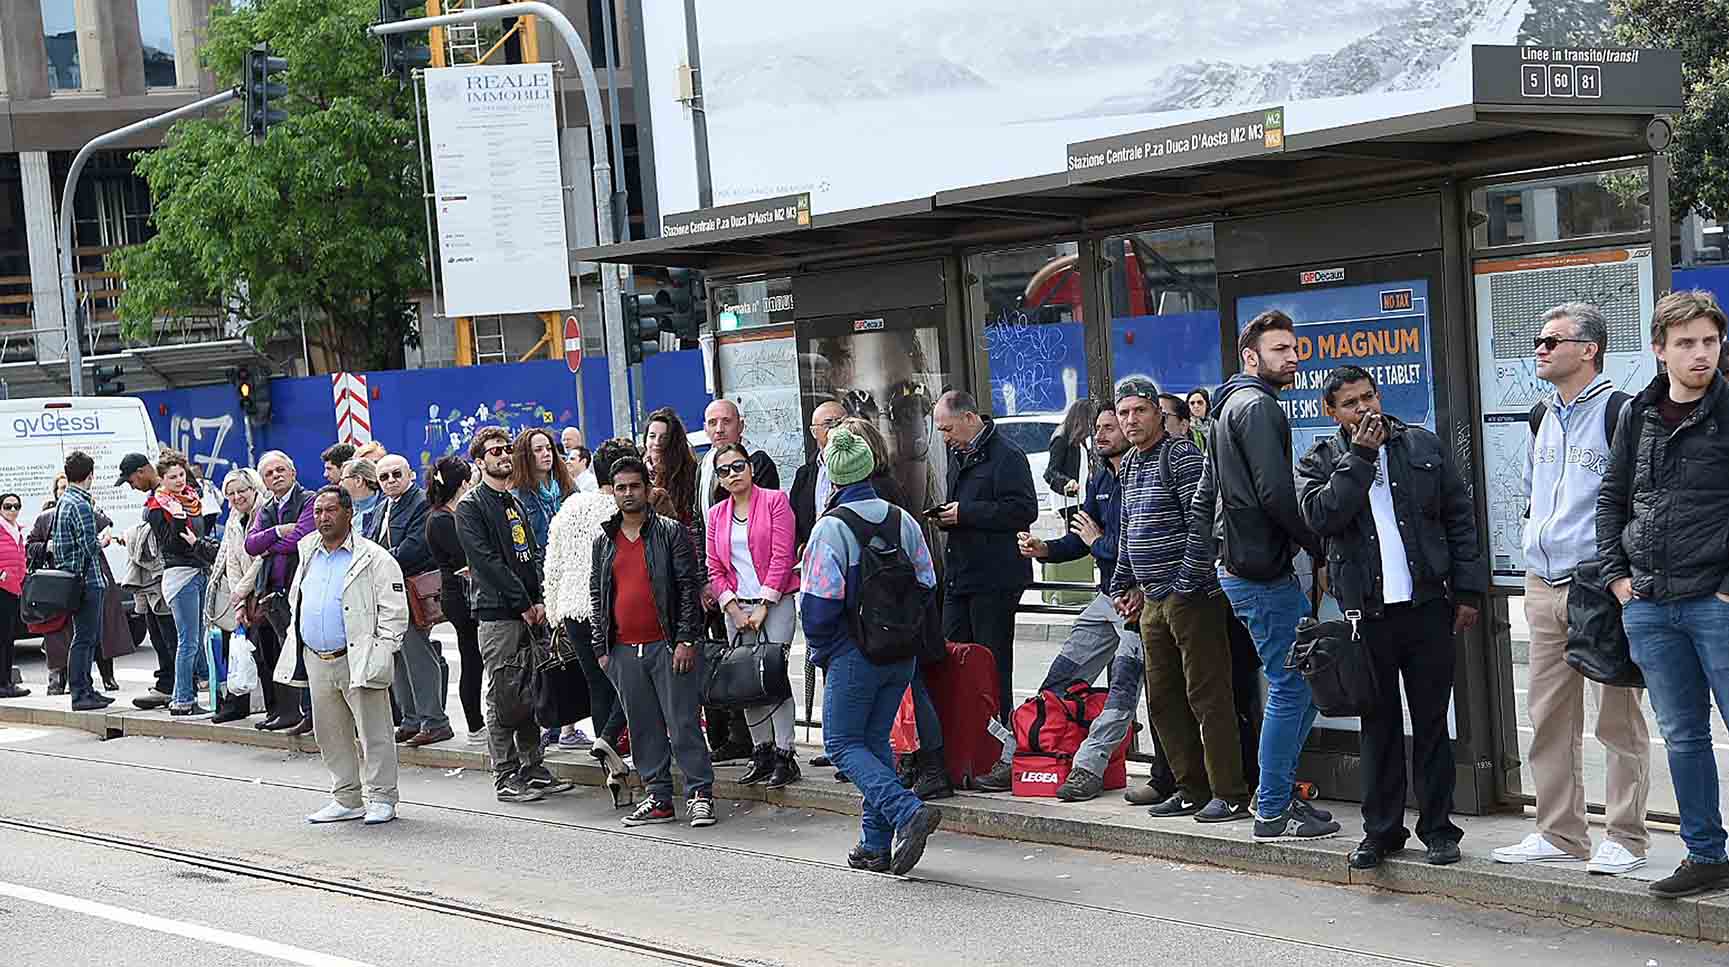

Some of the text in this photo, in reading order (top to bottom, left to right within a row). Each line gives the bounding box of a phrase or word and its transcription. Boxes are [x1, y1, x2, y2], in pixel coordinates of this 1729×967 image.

[1521, 47, 1549, 61] Linee
[1552, 48, 1562, 61] in
[467, 73, 548, 90] REALE
[1530, 73, 1538, 88] 5
[1554, 73, 1568, 88] 60
[1581, 75, 1595, 89] 81
[467, 89, 550, 103] IMMOBILI
[1266, 112, 1280, 126] M2
[1266, 131, 1281, 145] M3
[1068, 153, 1105, 171] Stazione
[1106, 147, 1143, 164] Centrale
[1166, 138, 1190, 154] Duca
[1191, 132, 1228, 149] D'Aosta
[1230, 127, 1246, 142] M2
[1248, 123, 1264, 140] M3
[663, 223, 690, 238] Stazione
[690, 220, 715, 234] Centrale
[731, 216, 747, 228] Duca
[774, 208, 784, 221] M2
[785, 207, 797, 219] M3
[1383, 294, 1409, 309] NO TAX
[1296, 327, 1420, 361] D MAGNUM
[1294, 370, 1308, 390] DA
[1377, 367, 1384, 385] E
[1300, 399, 1319, 419] SMS
[13, 410, 100, 438] gvGessi
[1021, 771, 1058, 783] LEGEA
